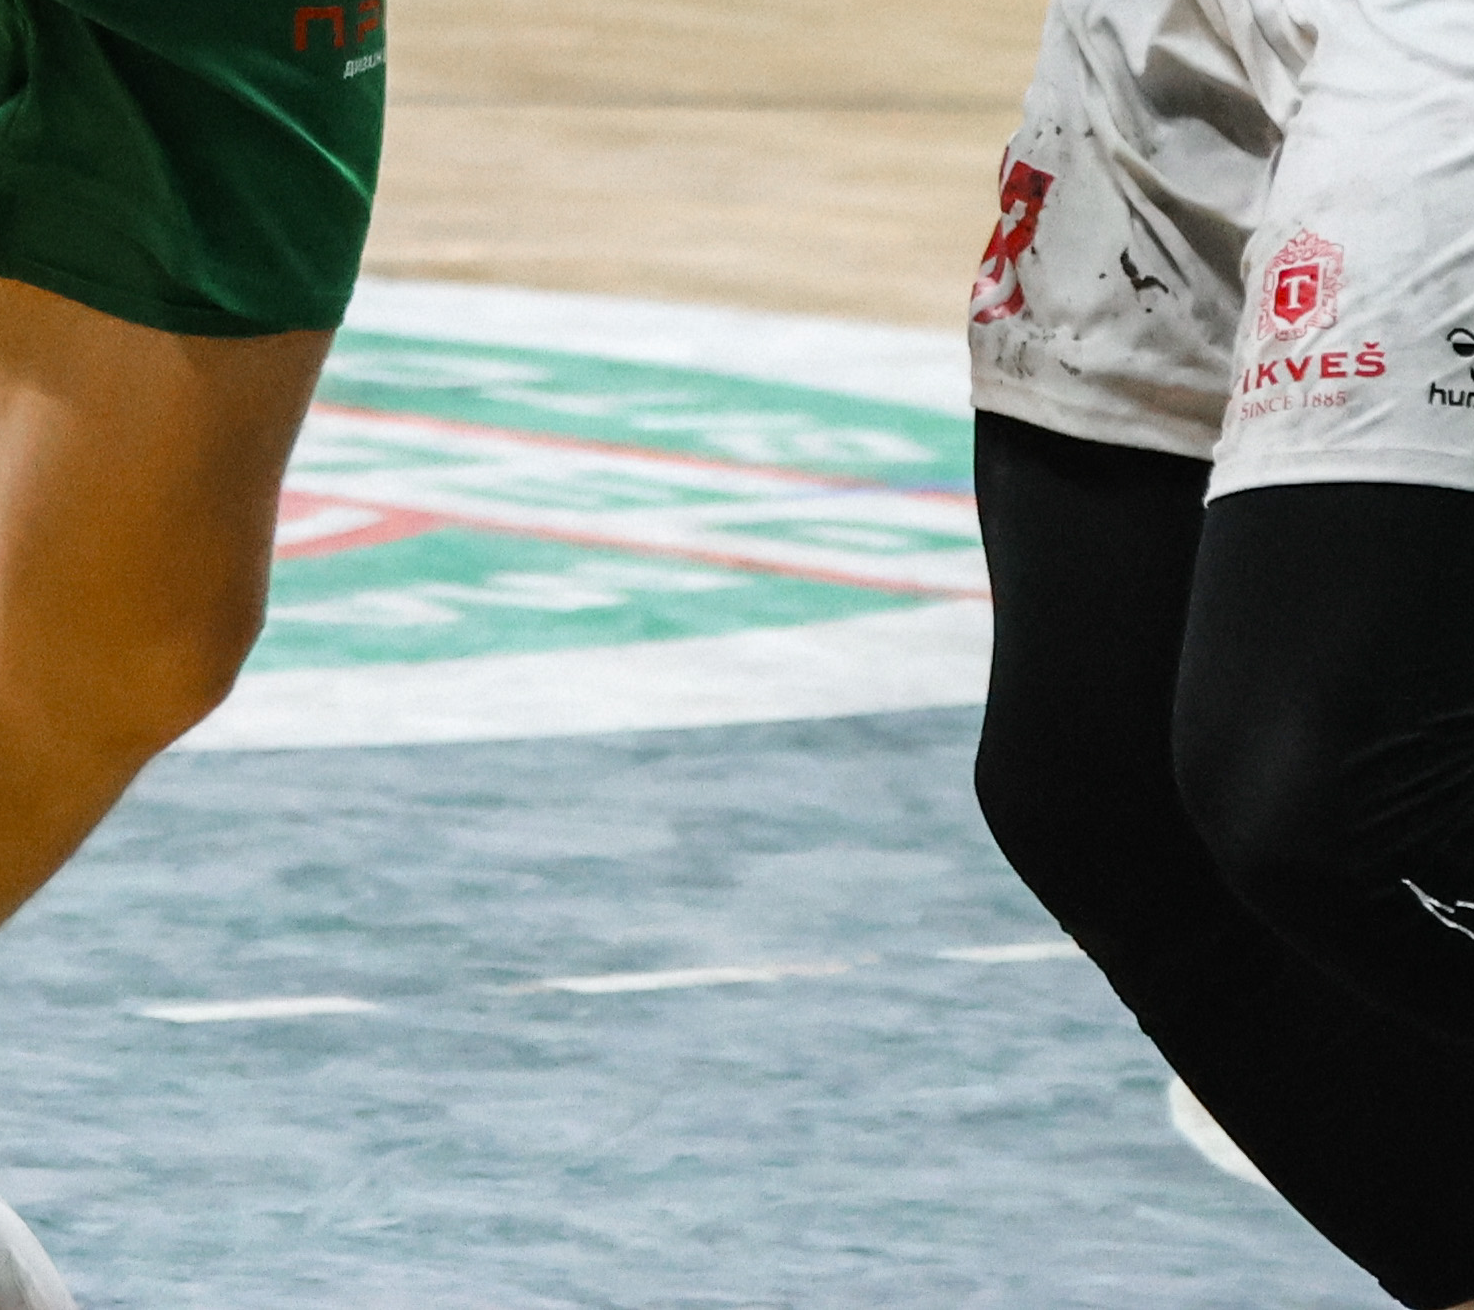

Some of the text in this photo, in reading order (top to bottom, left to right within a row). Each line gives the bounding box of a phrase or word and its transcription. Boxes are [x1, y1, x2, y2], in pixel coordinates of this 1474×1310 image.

[1242, 341, 1387, 394] IKVEŠ
[1239, 389, 1348, 421] SINCE 1885
